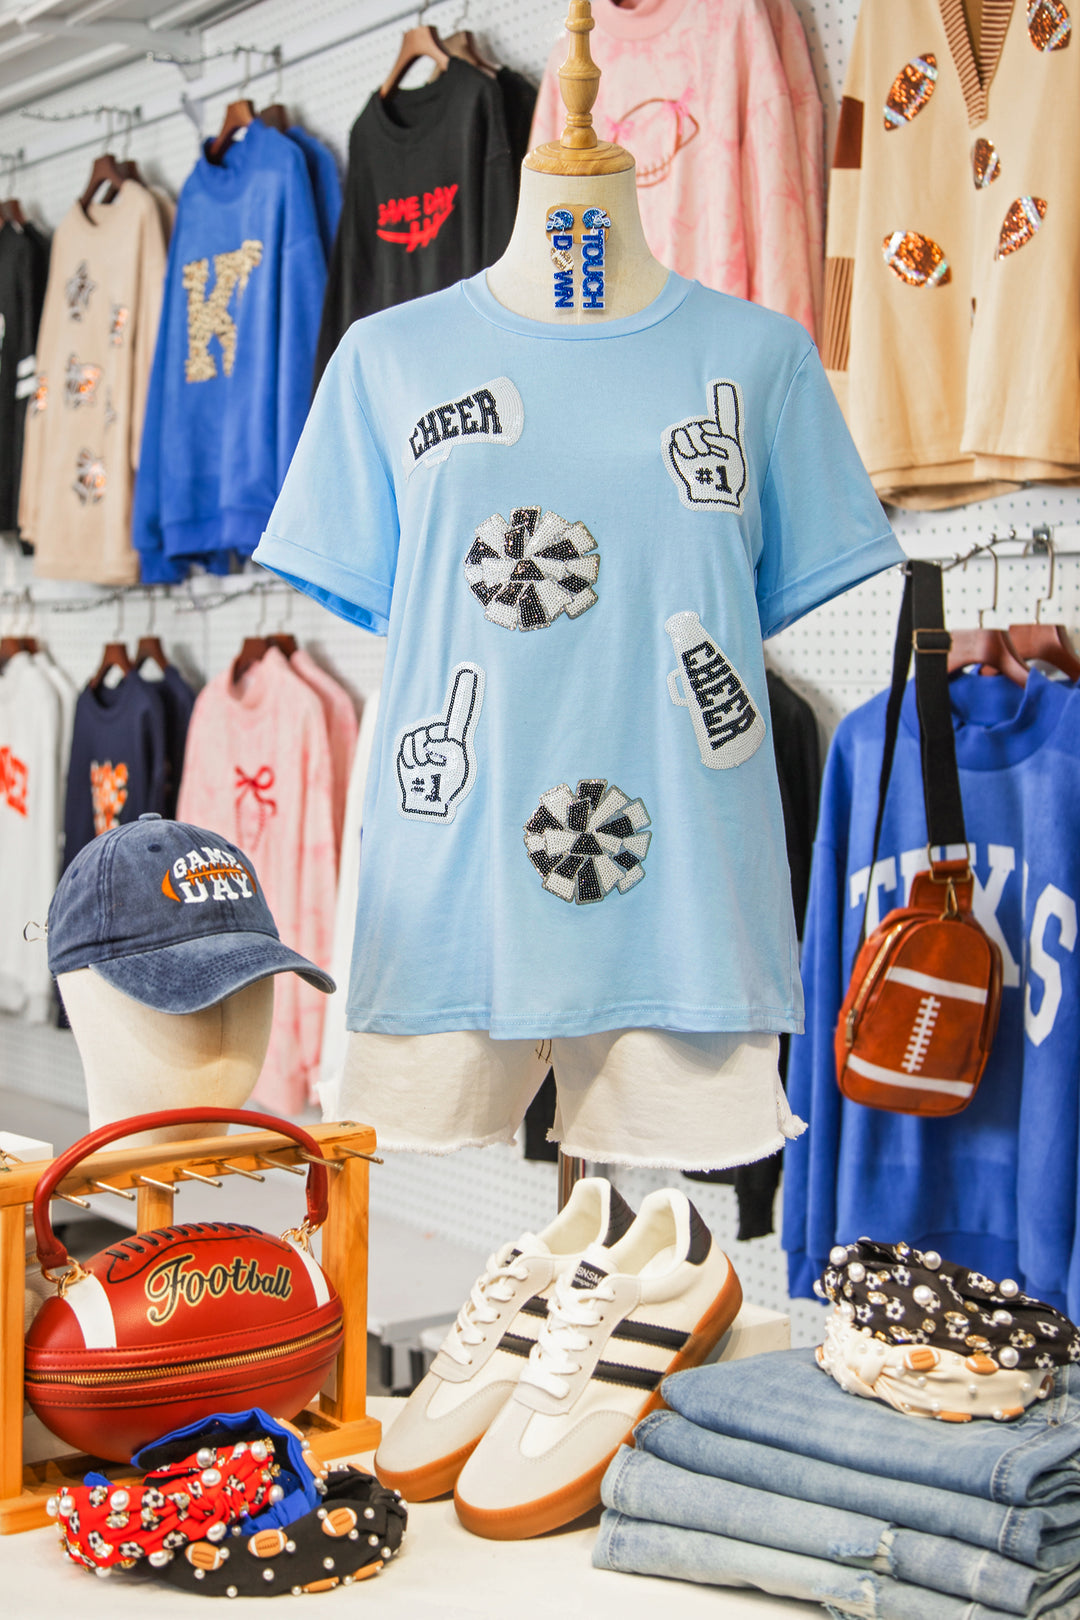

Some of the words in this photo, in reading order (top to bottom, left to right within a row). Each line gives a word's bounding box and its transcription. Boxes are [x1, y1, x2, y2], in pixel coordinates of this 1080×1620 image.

[552, 234, 574, 308] DWN
[582, 229, 605, 308] TOUCH
[408, 388, 503, 461] CHEER
[695, 465, 732, 494] #1
[681, 640, 757, 750] CHEER
[411, 773, 442, 802] #1
[179, 872, 253, 904] DAY
[850, 842, 1078, 1047] TXS
[145, 1253, 293, 1326] Football
